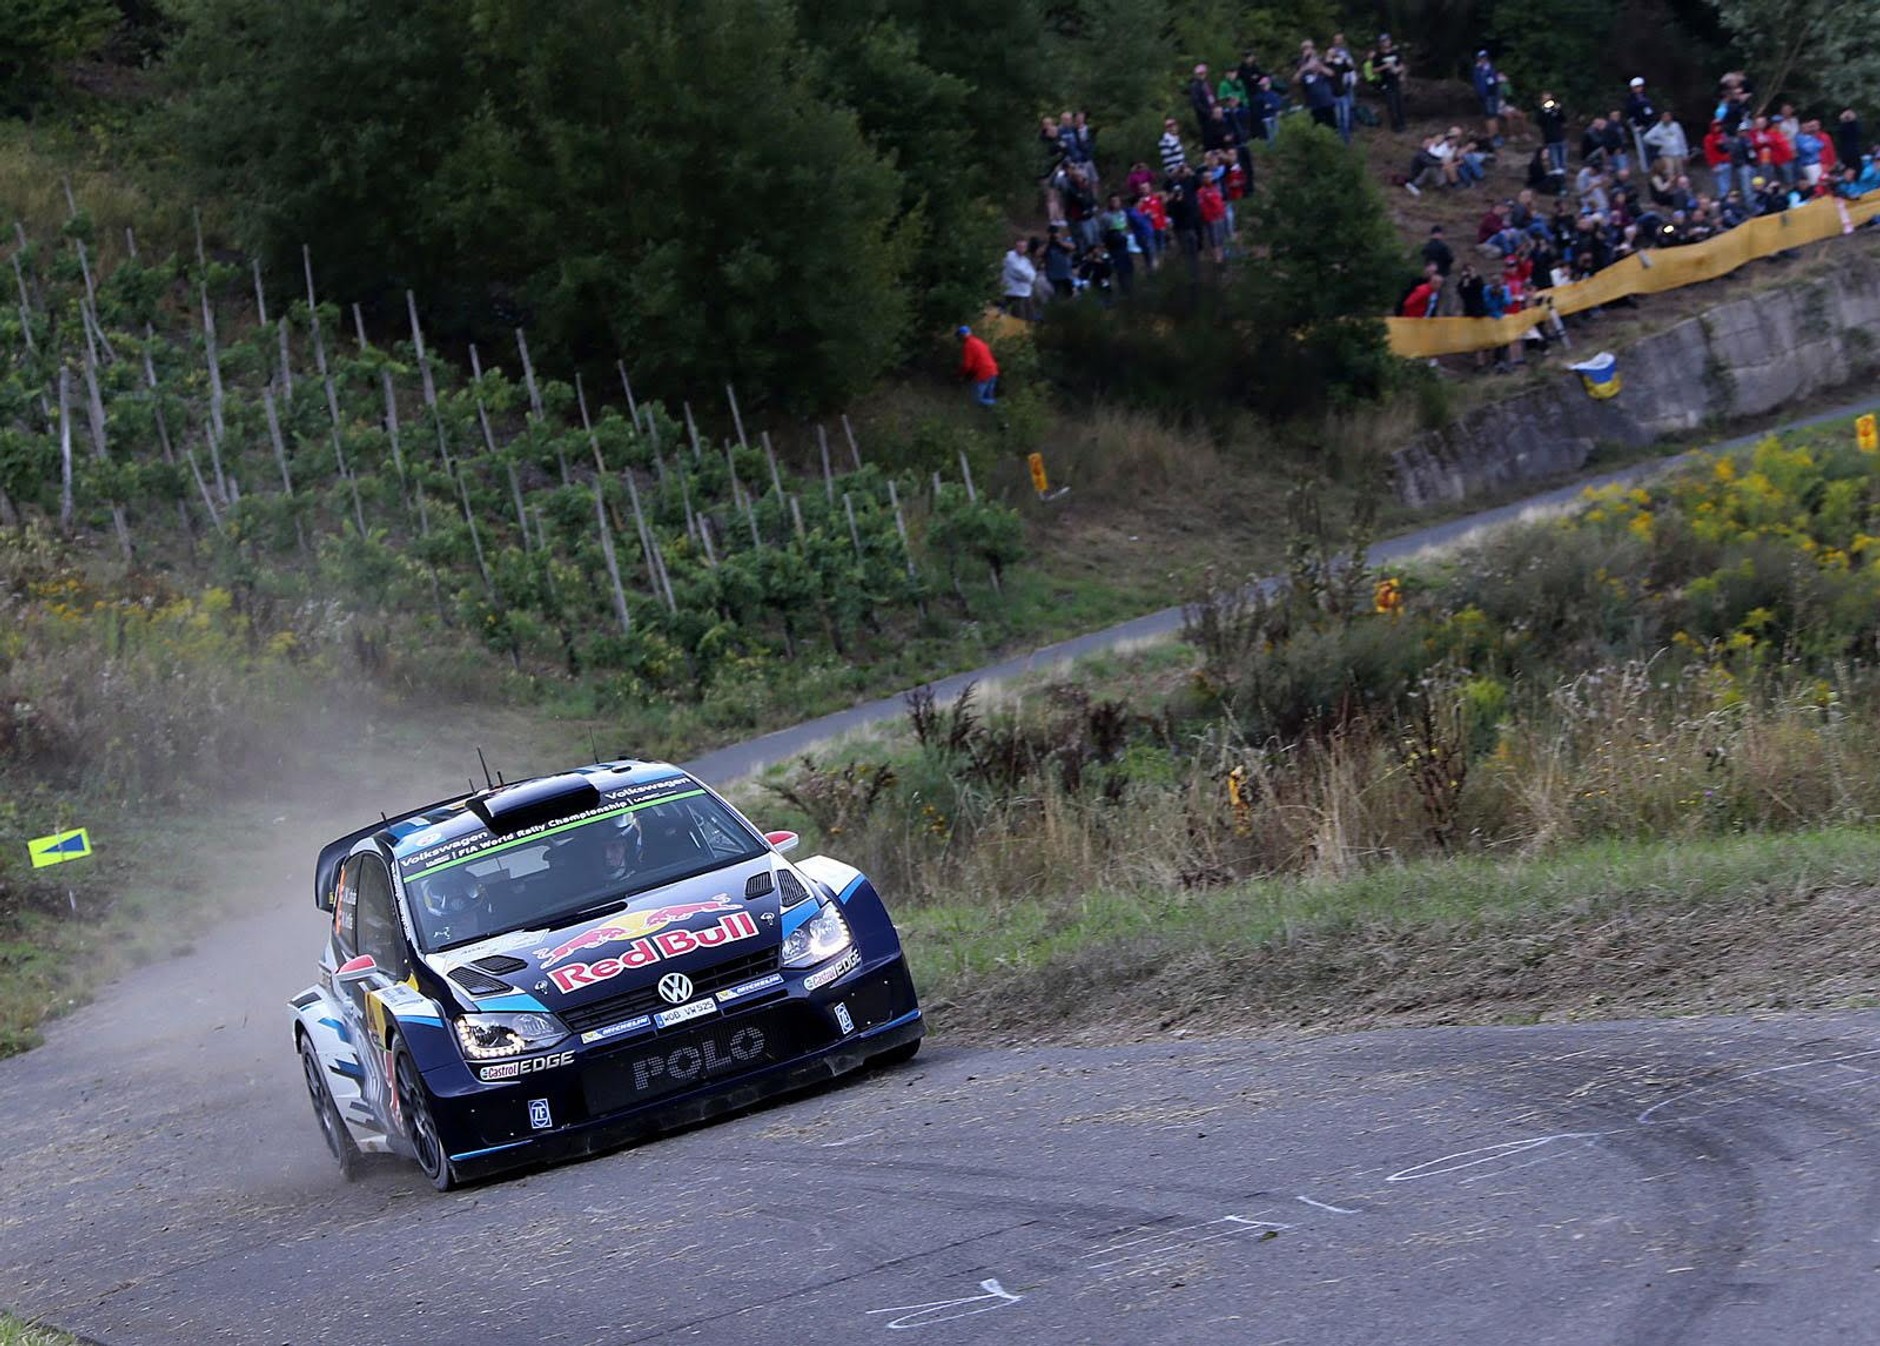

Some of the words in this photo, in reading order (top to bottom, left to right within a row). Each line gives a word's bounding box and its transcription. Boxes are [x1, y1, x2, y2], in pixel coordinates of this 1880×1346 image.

[605, 777, 691, 800] Volkswagen
[458, 846, 478, 857] FIA
[480, 833, 514, 849] World
[517, 822, 546, 838] Rally
[548, 799, 628, 828] Championship
[401, 831, 488, 867] Volkswagen
[548, 940, 660, 993] Red
[653, 911, 759, 959] Bull
[836, 948, 862, 976] EDGE
[736, 975, 780, 994] MICHELIN
[602, 1017, 648, 1036] MICHELIN
[662, 1010, 681, 1022] WOB
[488, 1064, 517, 1079] Castrol
[519, 1050, 576, 1075] EDGE
[632, 1026, 766, 1091] POLO
